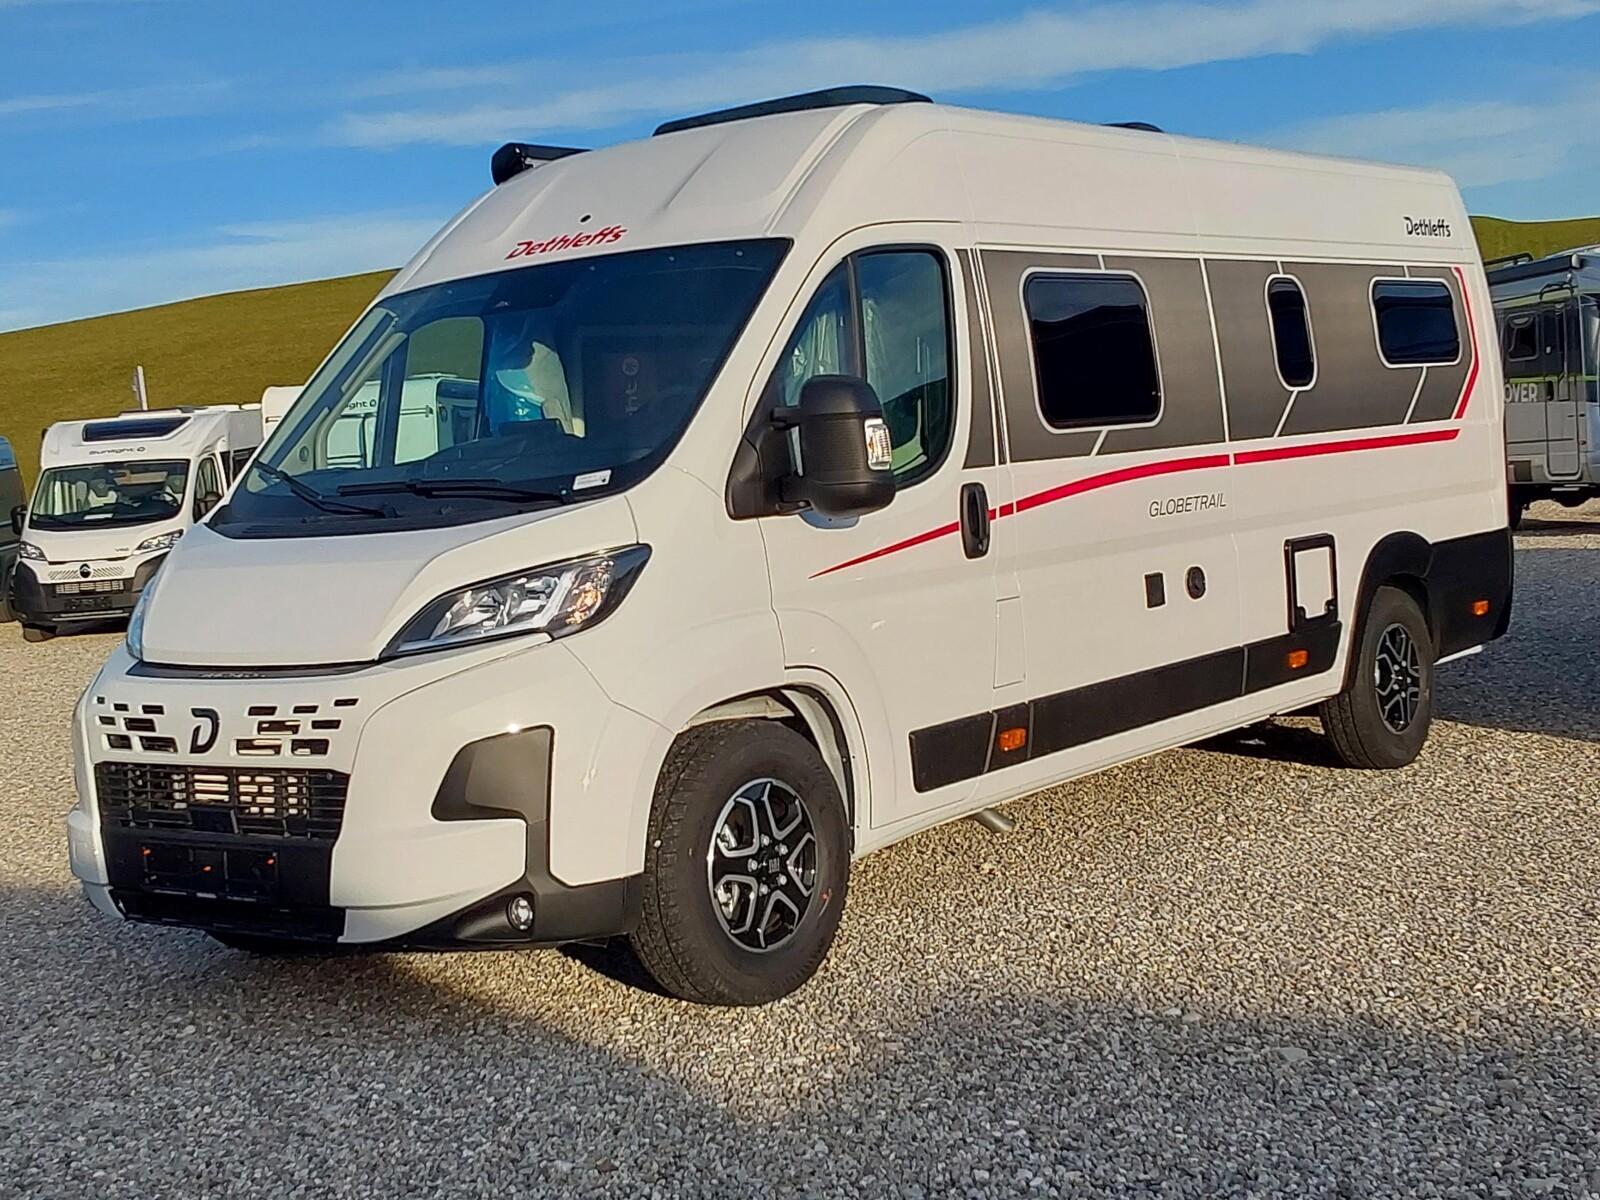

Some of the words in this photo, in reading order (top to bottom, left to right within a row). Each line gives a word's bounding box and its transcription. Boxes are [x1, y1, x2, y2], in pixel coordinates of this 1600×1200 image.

[1403, 216, 1451, 237] Dethleffs
[504, 225, 627, 260] Dethleffs
[1149, 493, 1227, 517] GLOBETRAIL
